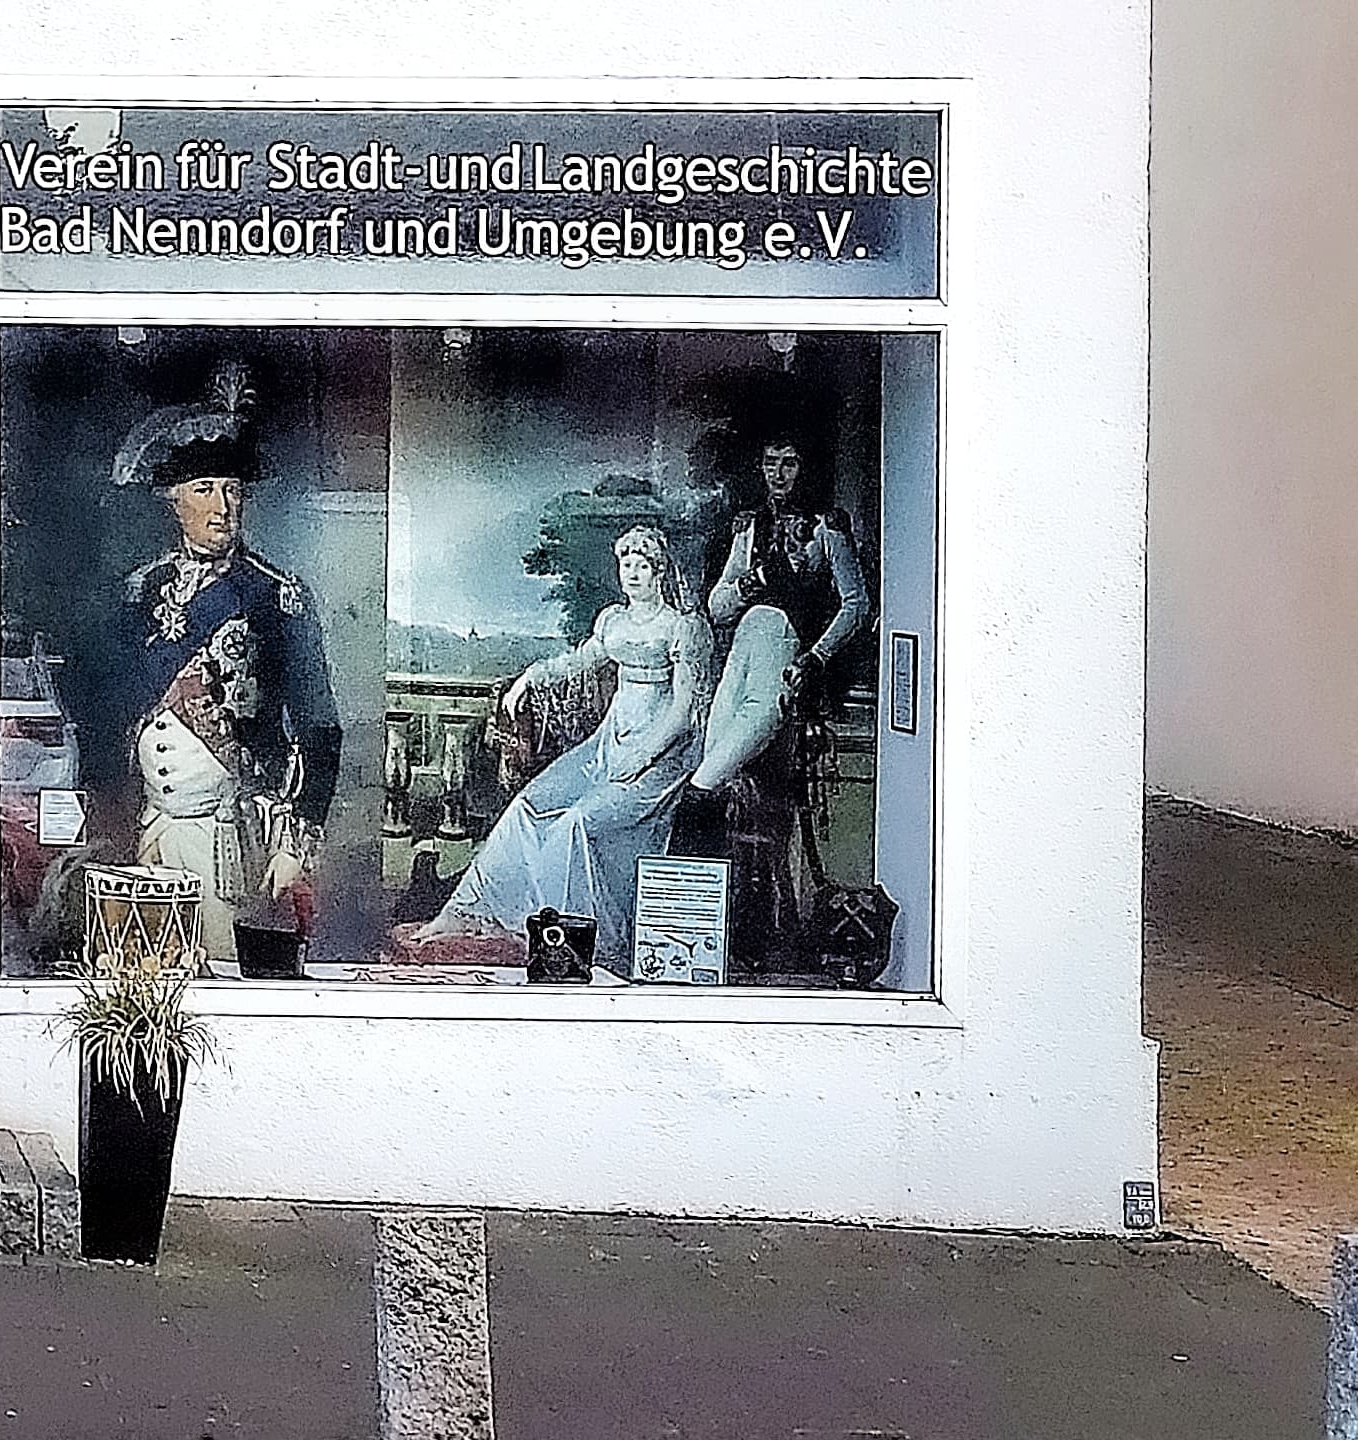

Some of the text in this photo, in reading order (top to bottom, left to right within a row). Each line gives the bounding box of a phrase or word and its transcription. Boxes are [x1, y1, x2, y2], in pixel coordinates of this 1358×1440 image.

[1, 143, 164, 191] Verein
[177, 143, 251, 191] für
[535, 144, 932, 203] Landgeschichte
[1, 207, 92, 254] Bad
[111, 208, 349, 255] Nenndorf
[364, 209, 457, 255] und
[479, 210, 747, 268] Umgebung
